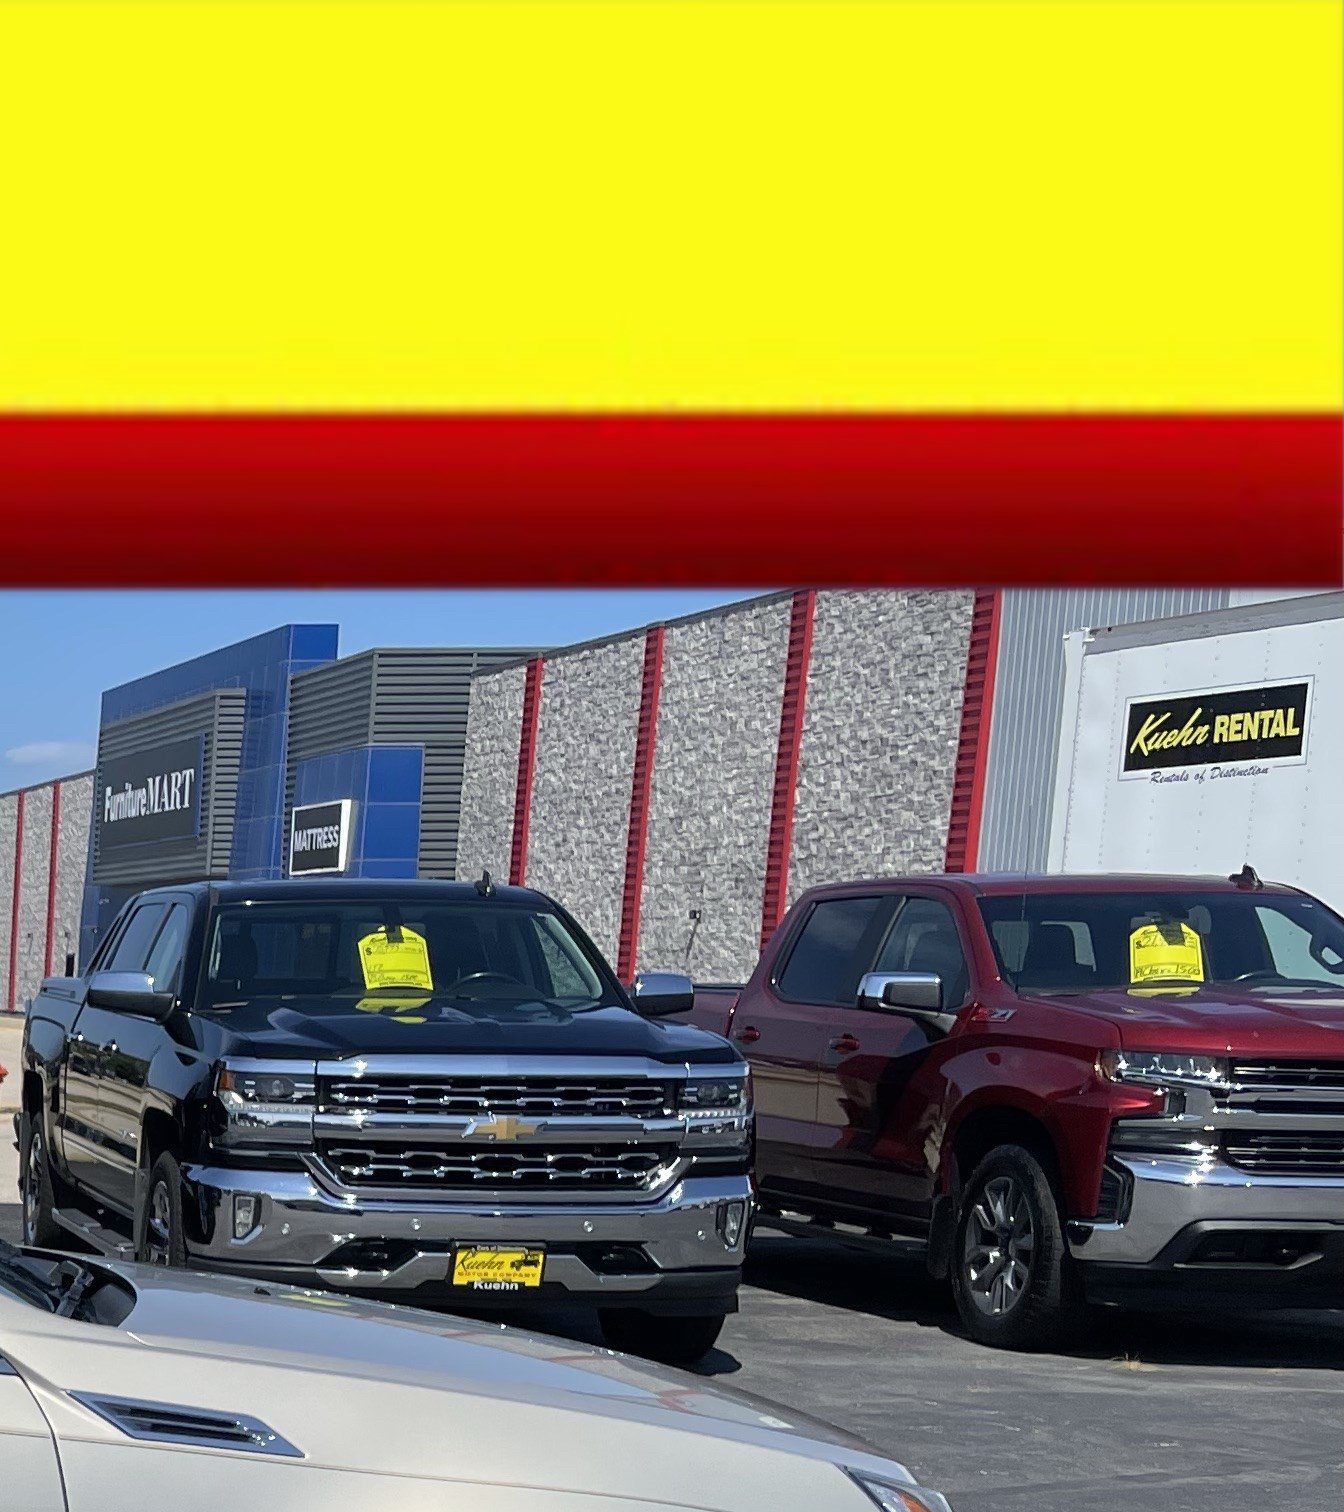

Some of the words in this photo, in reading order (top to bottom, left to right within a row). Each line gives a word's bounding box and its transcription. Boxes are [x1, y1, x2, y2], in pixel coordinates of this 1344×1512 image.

[1129, 707, 1210, 757] Kuehn
[1213, 707, 1301, 744] RENTAL
[1150, 771, 1189, 784] Rentals
[1194, 768, 1207, 784] of
[1210, 766, 1269, 780] Distinction
[294, 825, 339, 852] MATTRESS
[456, 1250, 505, 1272] Kuehn
[457, 1270, 489, 1278] MOTOR
[473, 1280, 519, 1291] Kuehn
